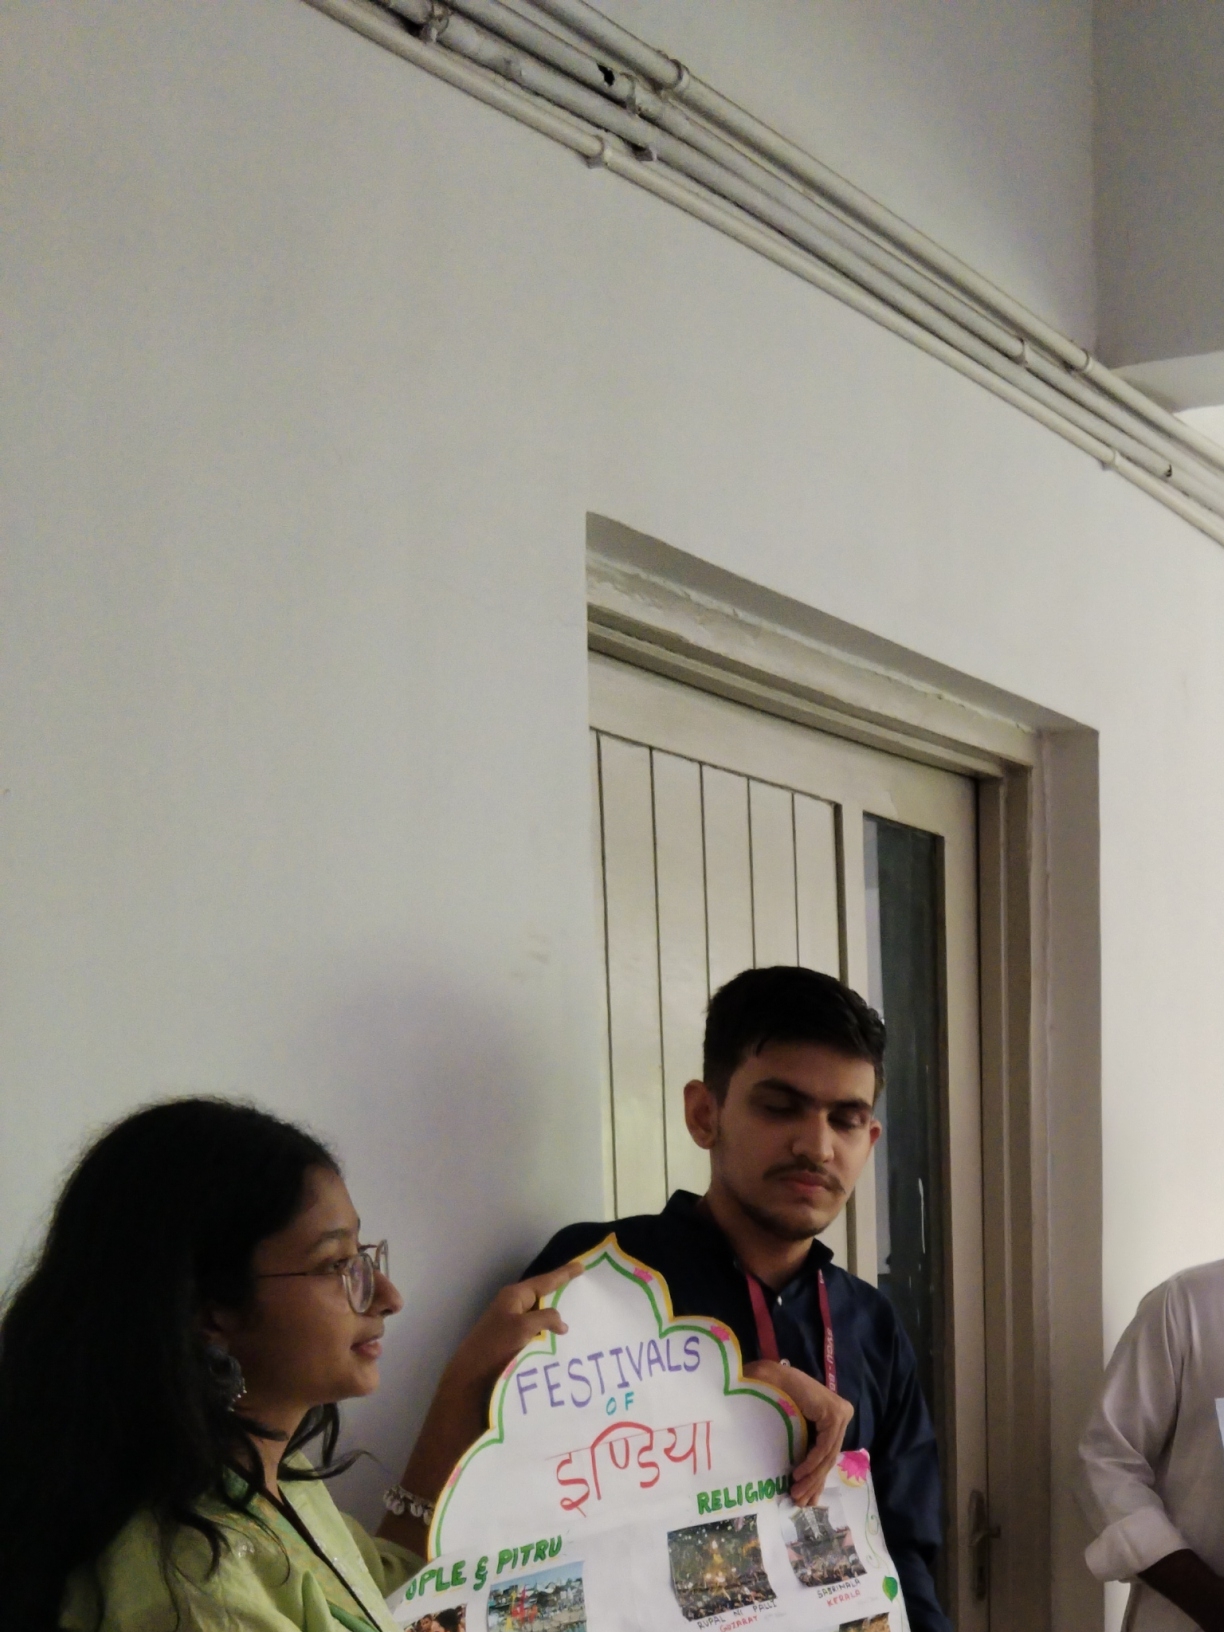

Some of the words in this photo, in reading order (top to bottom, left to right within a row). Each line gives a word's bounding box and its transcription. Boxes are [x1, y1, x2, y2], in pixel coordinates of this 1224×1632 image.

[516, 1336, 701, 1415] FESTIVALS
[606, 1391, 635, 1415] OF
[697, 1475, 791, 1515] RELIGIOU
[496, 1535, 563, 1575] PITRU
[826, 1590, 861, 1607] KERALA
[697, 1616, 726, 1631] RUPAL
